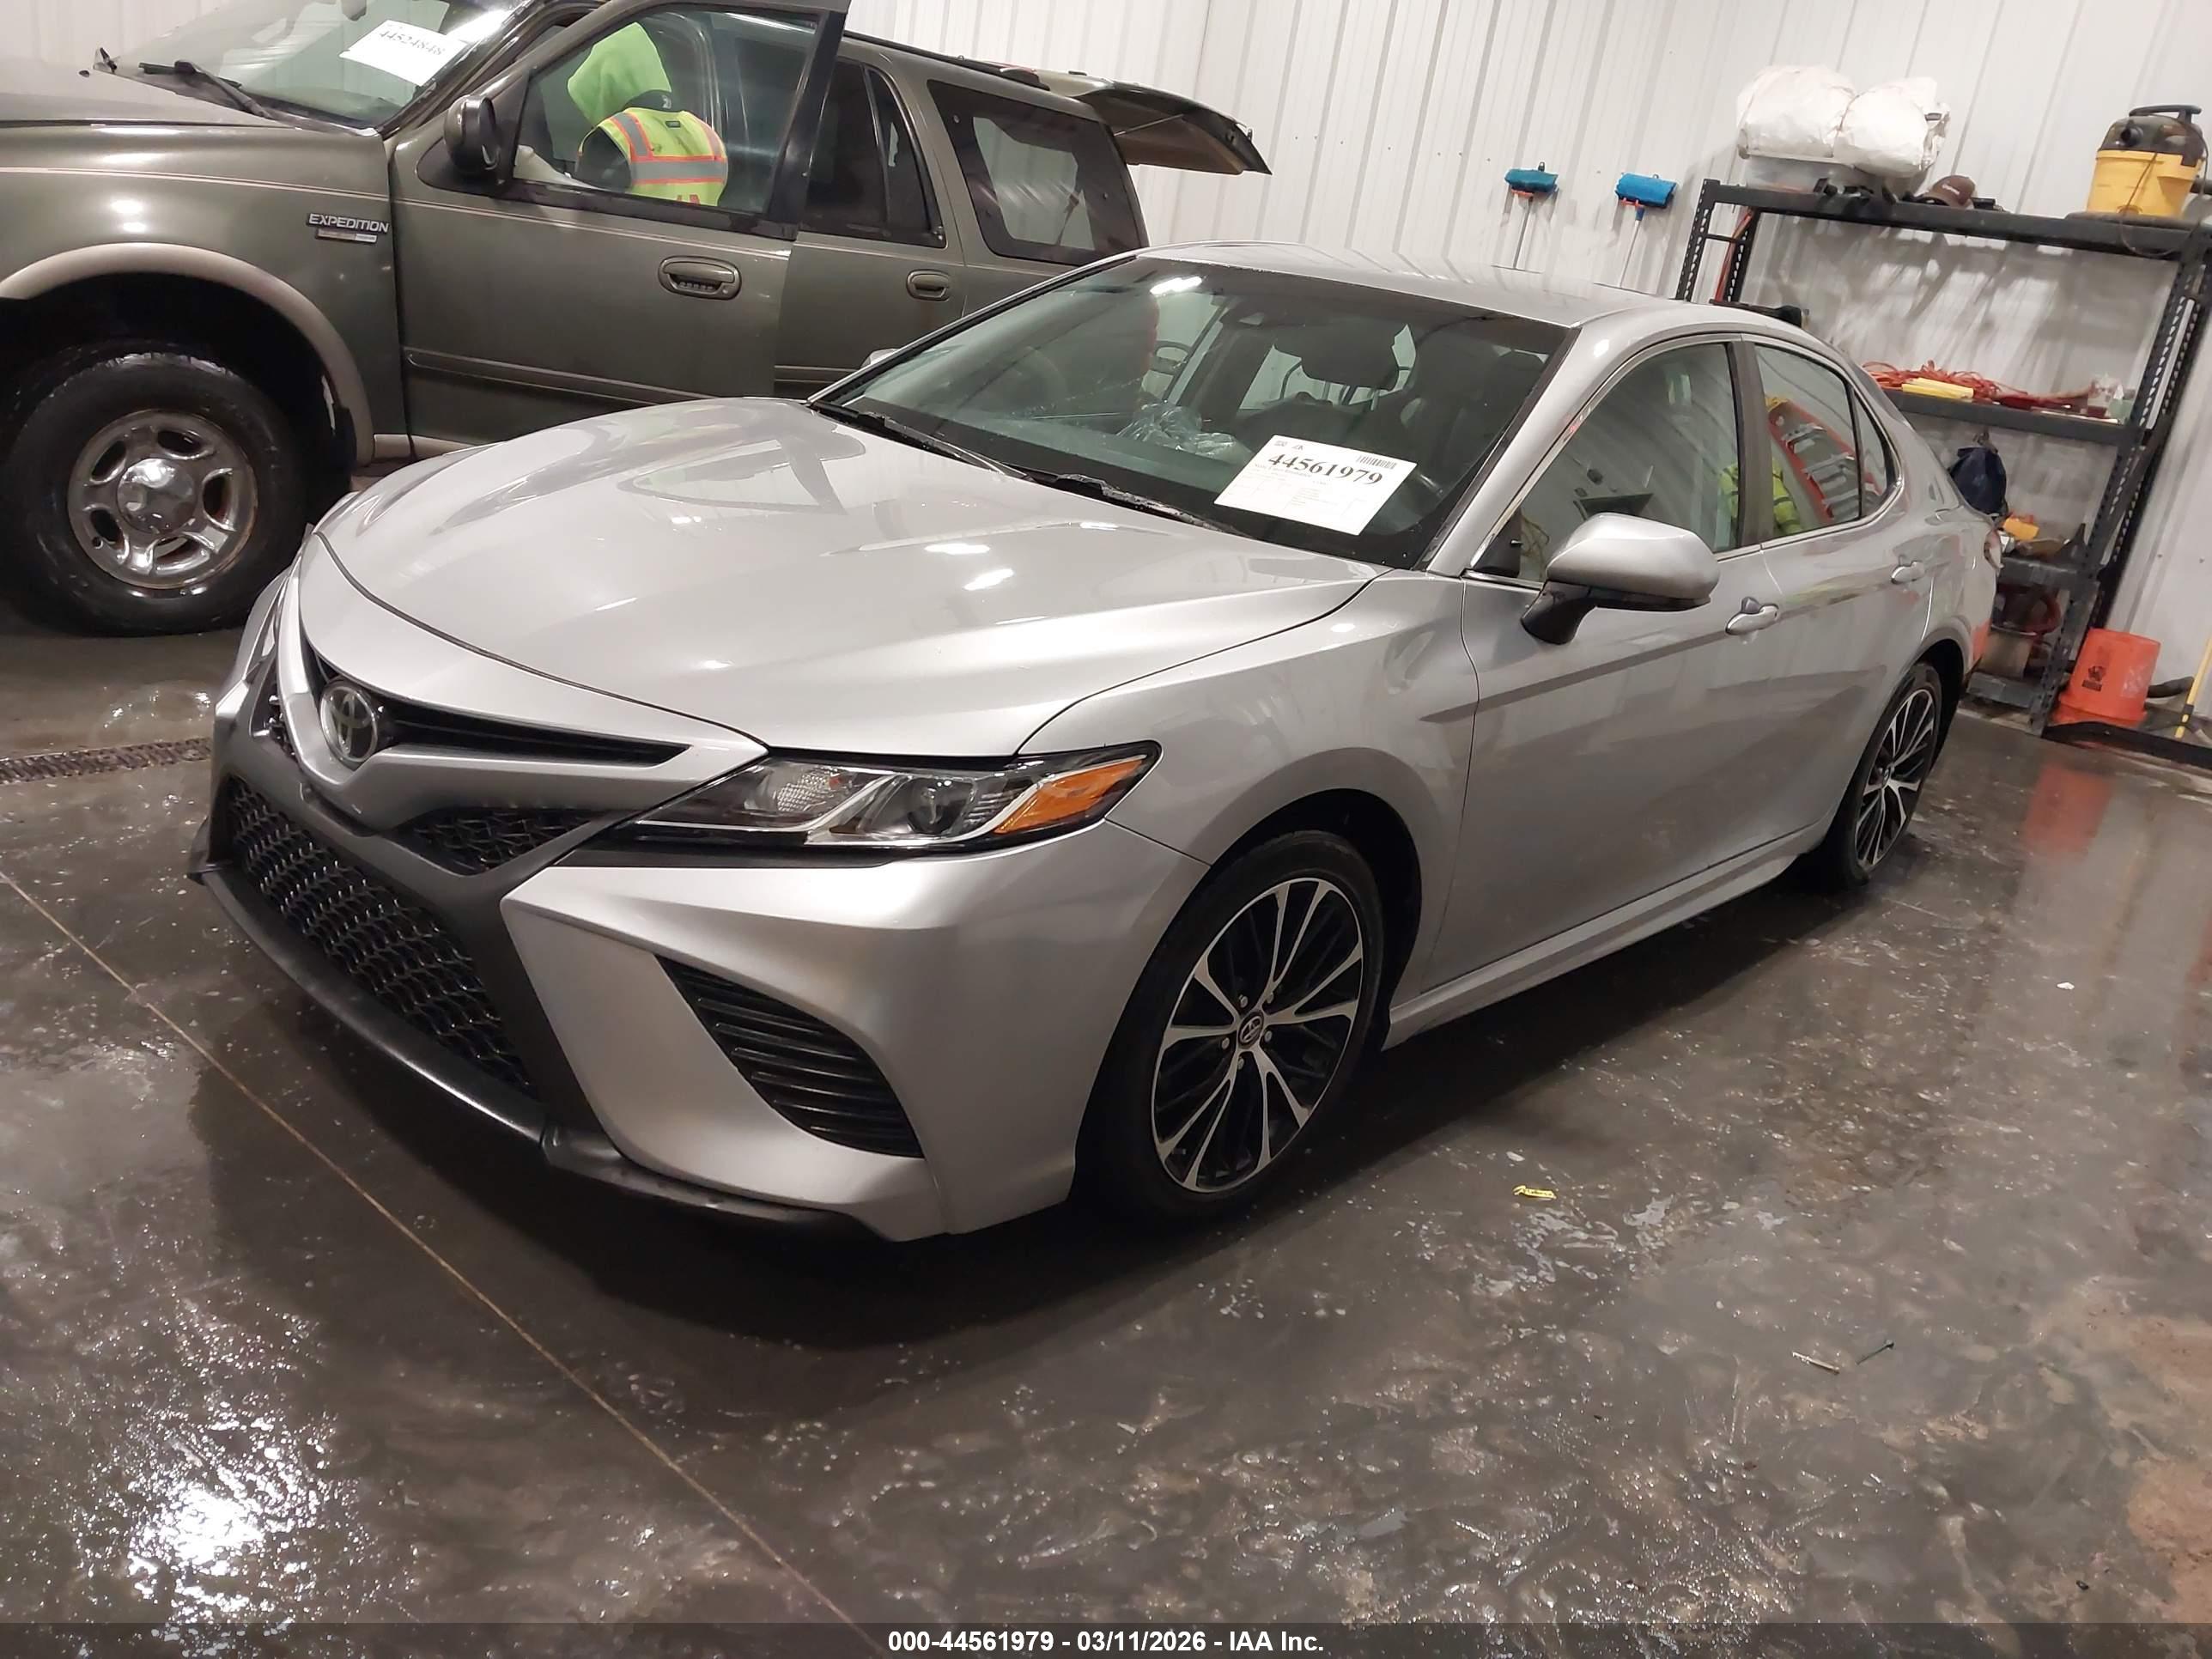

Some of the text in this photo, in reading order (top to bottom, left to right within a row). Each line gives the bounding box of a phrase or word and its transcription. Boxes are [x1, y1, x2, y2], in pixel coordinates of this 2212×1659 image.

[379, 30, 446, 56] 44524848
[308, 213, 389, 233] EXPEDITION
[1267, 453, 1383, 485] 44561979
